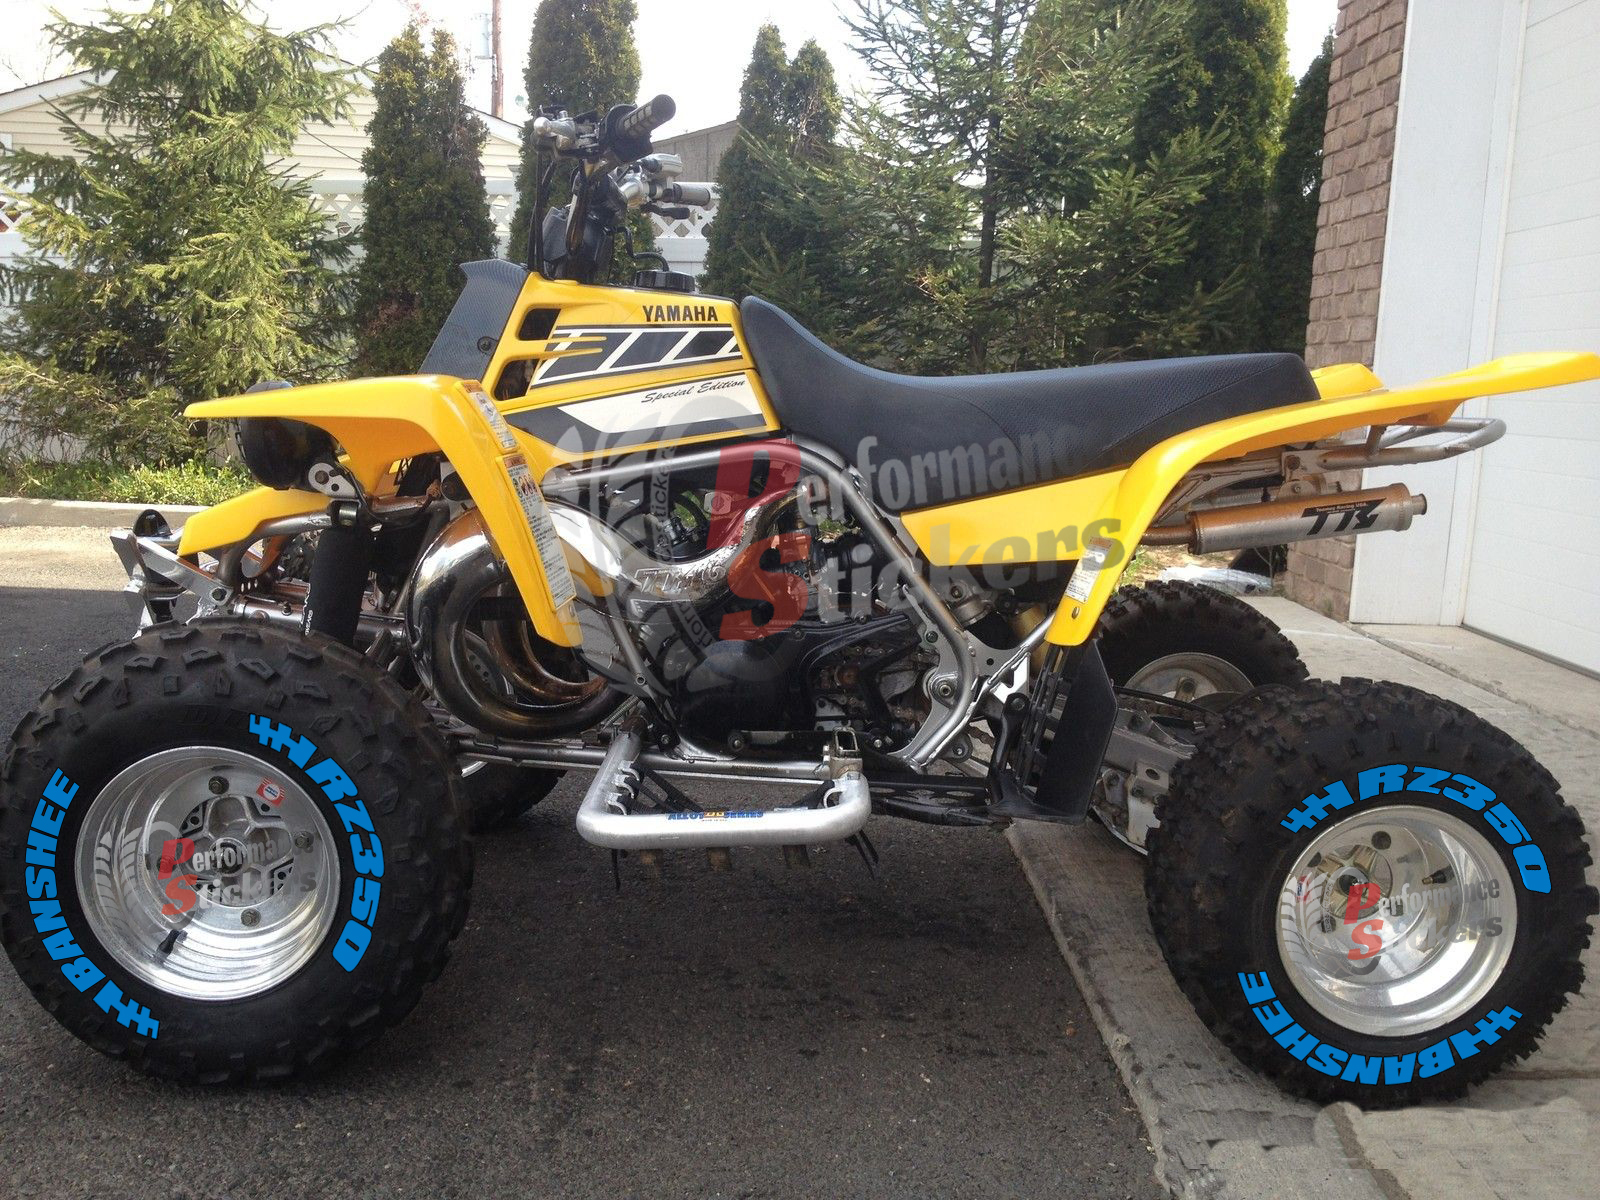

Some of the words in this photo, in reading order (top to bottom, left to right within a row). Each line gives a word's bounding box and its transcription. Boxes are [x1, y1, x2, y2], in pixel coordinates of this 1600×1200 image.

[642, 305, 719, 322] YAMAHA
[641, 385, 695, 403] Special
[697, 379, 746, 394] Edition
[25, 767, 106, 993] BANSHEE
[304, 757, 385, 972] RZ350
[1357, 763, 1552, 894] RZ350
[1237, 971, 1456, 1085] BANSHEE
